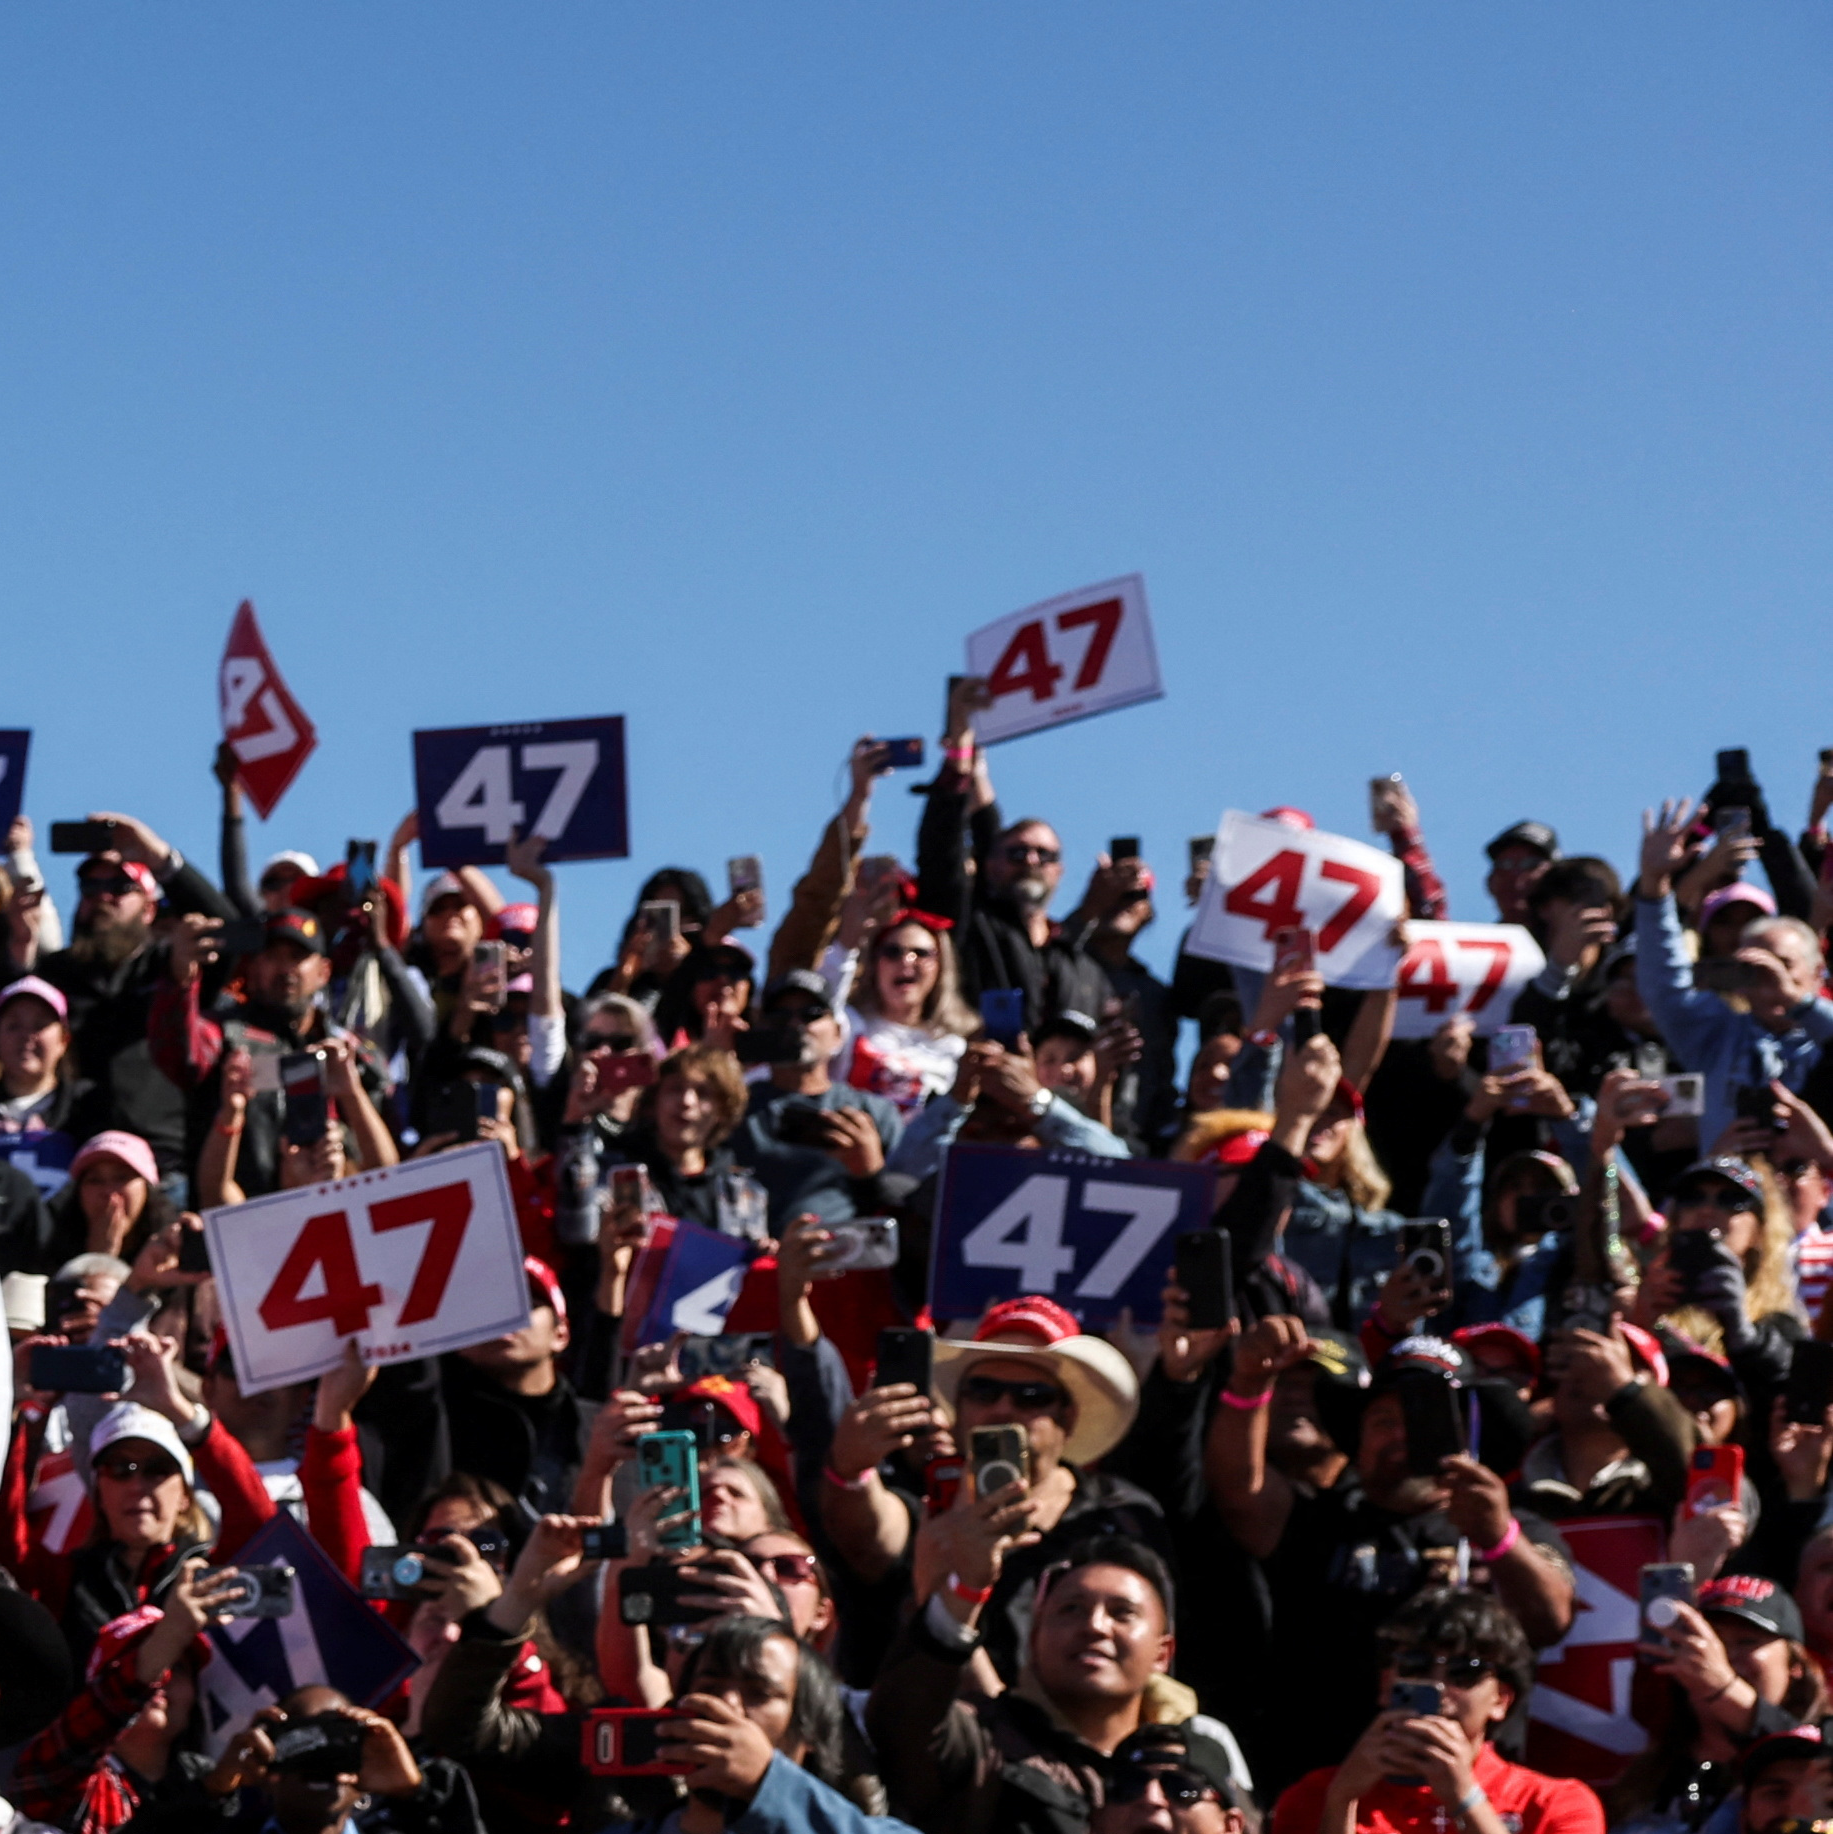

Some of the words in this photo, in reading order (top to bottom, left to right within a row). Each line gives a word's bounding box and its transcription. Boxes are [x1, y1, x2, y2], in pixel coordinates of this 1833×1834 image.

[987, 599, 1123, 701] 47
[436, 740, 600, 845] 47
[1226, 850, 1382, 953] 47
[1397, 939, 1513, 1014] 47
[258, 1180, 474, 1337] 47
[962, 1173, 1182, 1300] 47
